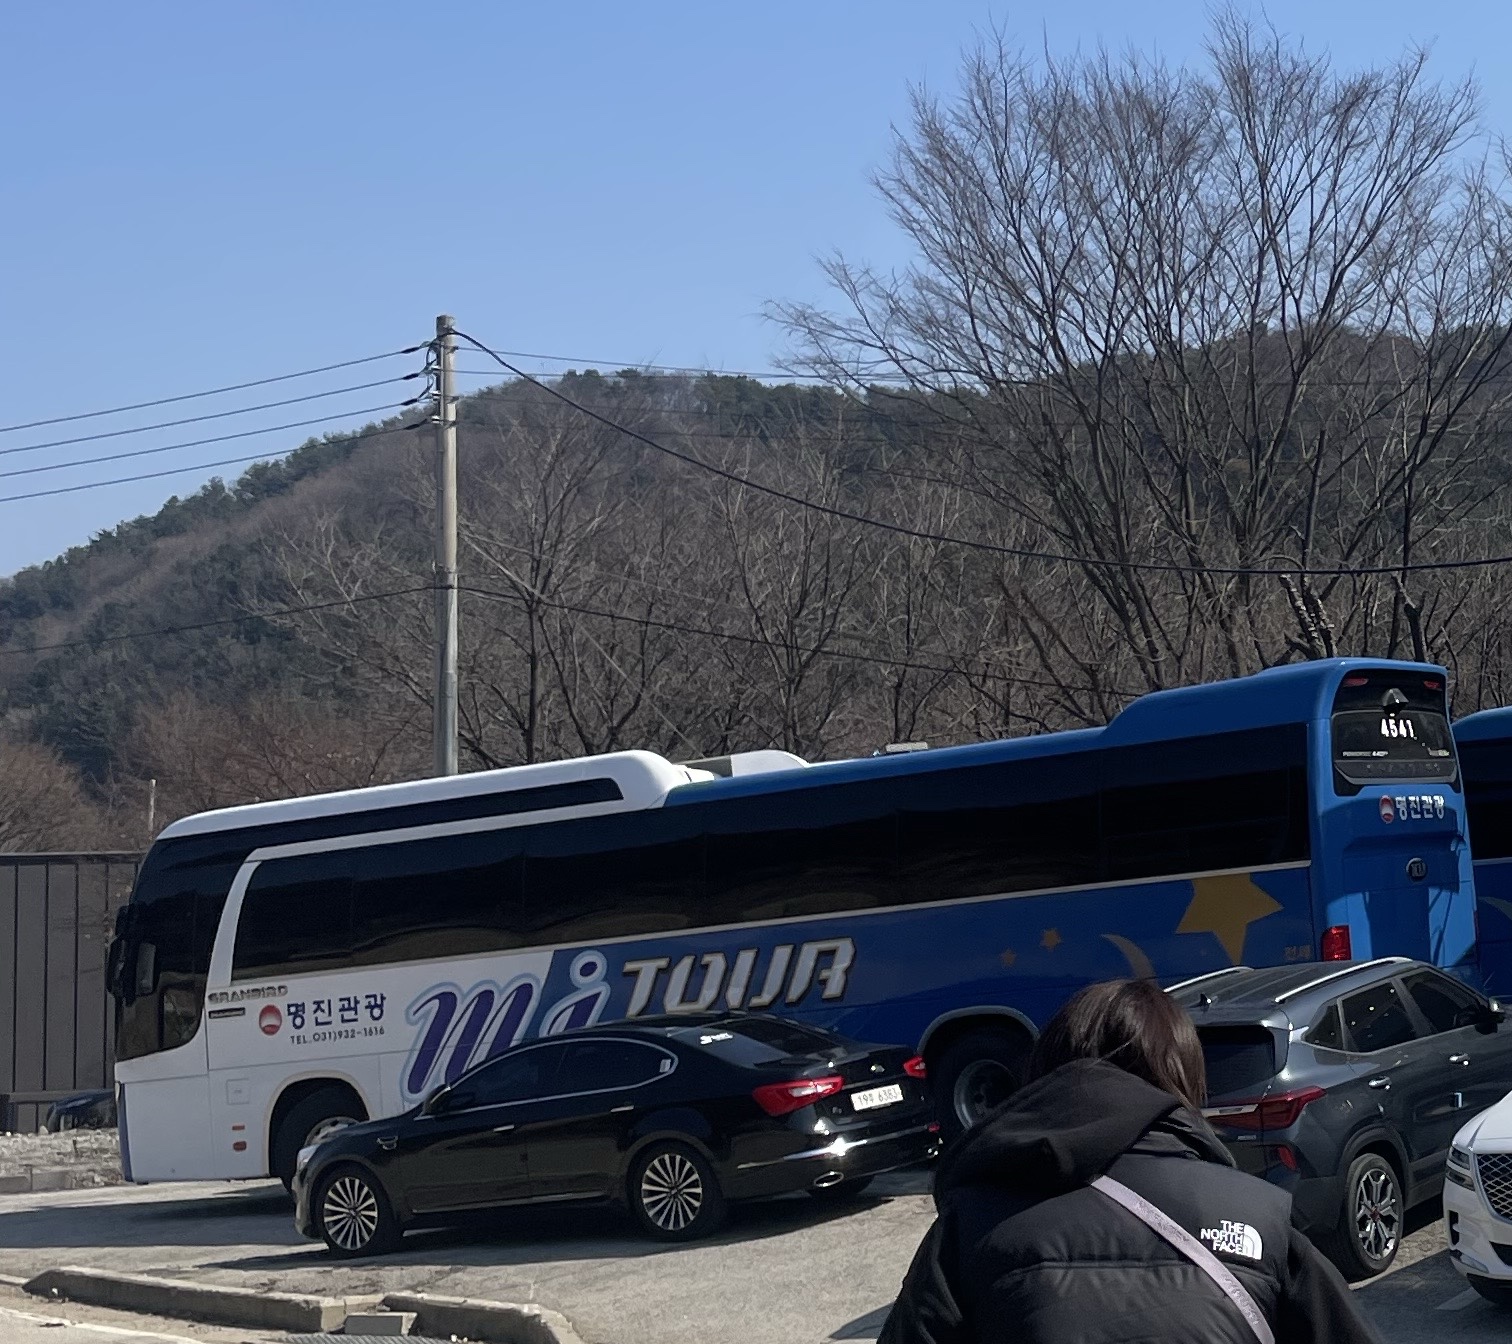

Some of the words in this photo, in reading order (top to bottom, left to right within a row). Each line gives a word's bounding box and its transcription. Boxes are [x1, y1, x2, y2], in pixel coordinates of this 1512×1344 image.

[1381, 718, 1414, 738] 4541
[1394, 795, 1445, 821] 명진관광
[622, 936, 855, 1019] TOUR
[286, 992, 387, 1030] 명진관광
[1200, 1227, 1244, 1245] NORTH
[1220, 1219, 1245, 1234] THE
[1212, 1239, 1244, 1255] FACE
